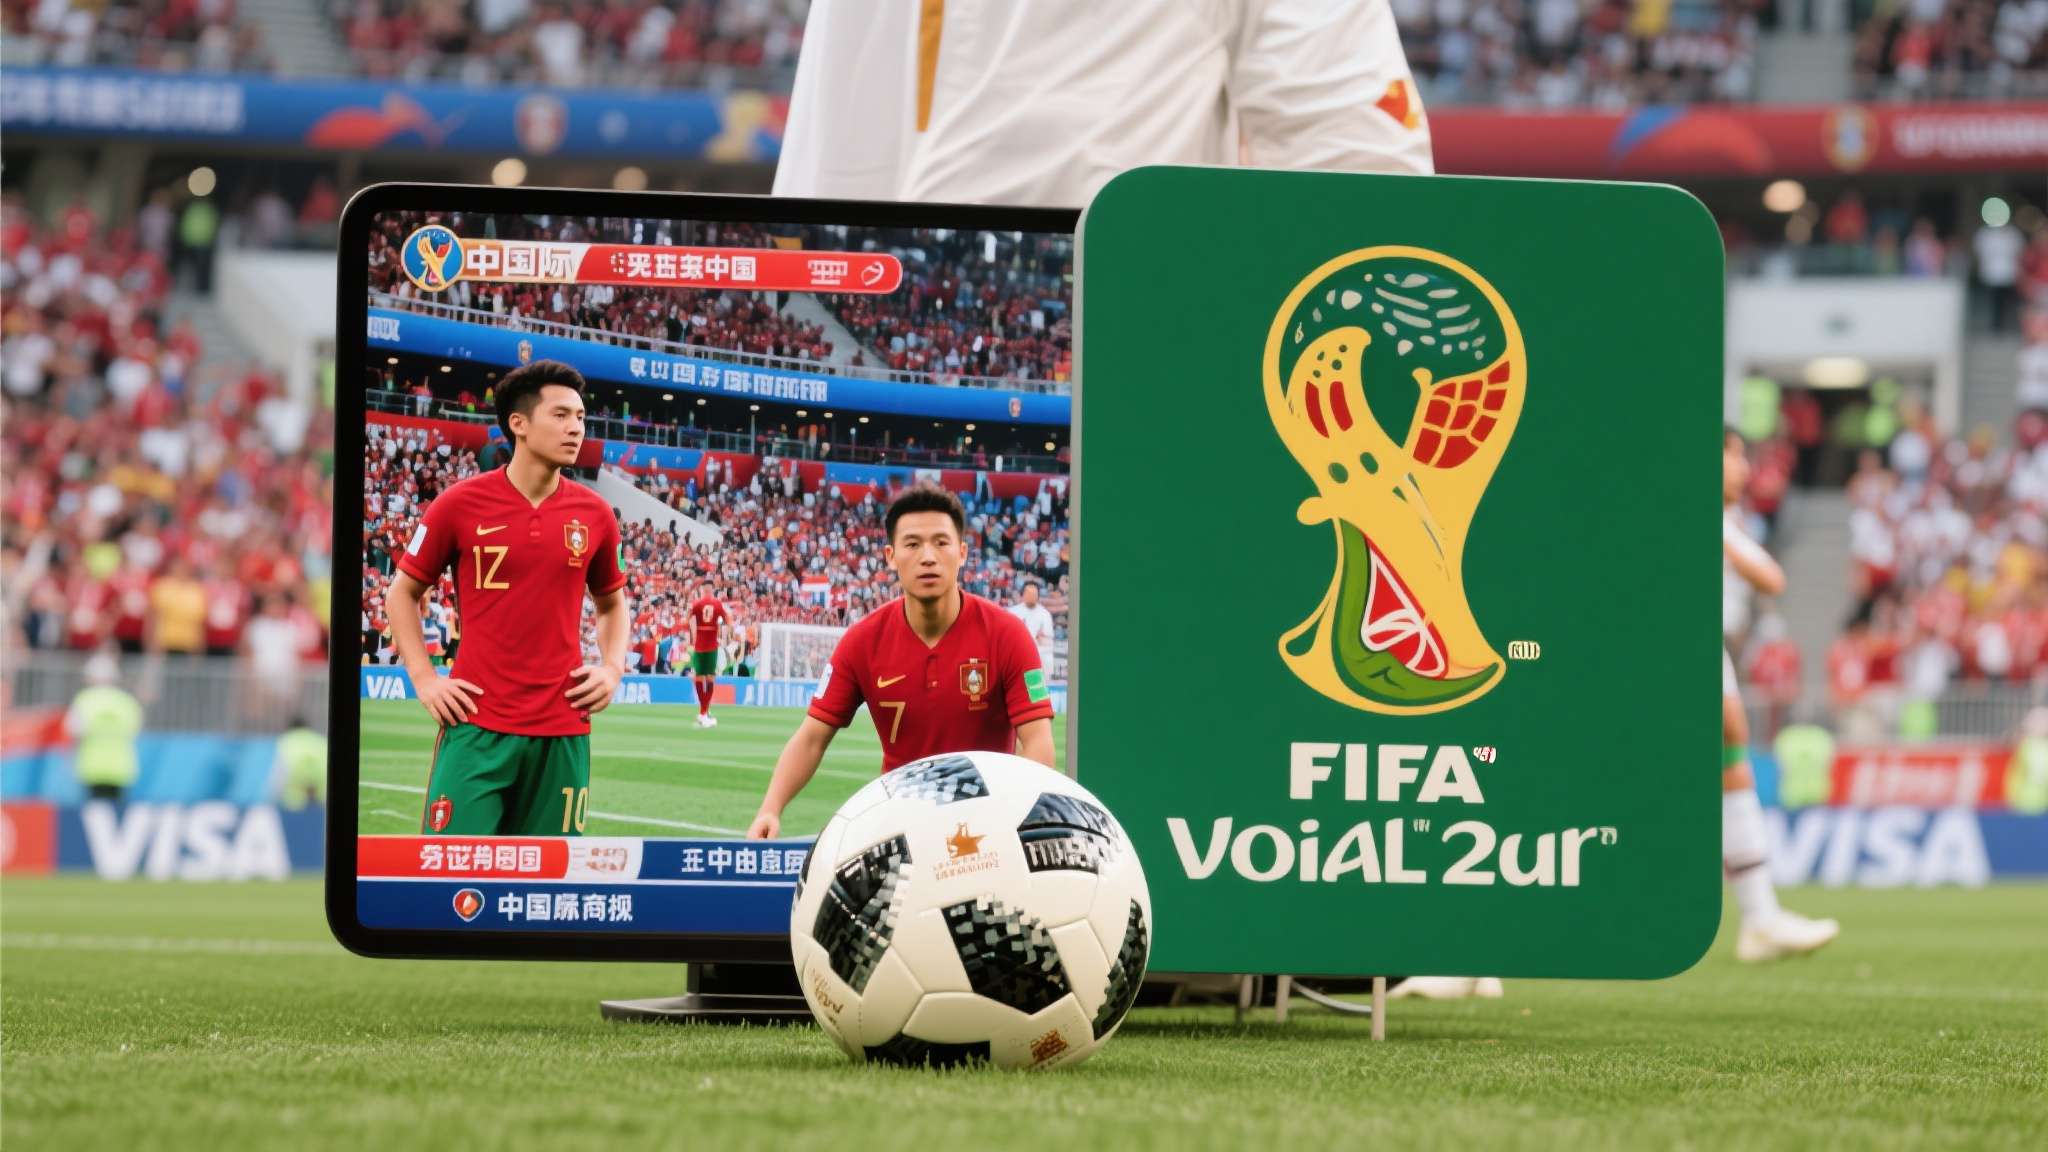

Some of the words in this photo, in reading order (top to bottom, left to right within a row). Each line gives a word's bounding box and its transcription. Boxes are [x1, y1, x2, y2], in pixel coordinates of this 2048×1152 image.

[880, 701, 906, 743] 7
[1290, 742, 1485, 803] FIFA
[562, 787, 588, 832] 10
[82, 801, 292, 882] VISA
[1766, 805, 1992, 888] VISA
